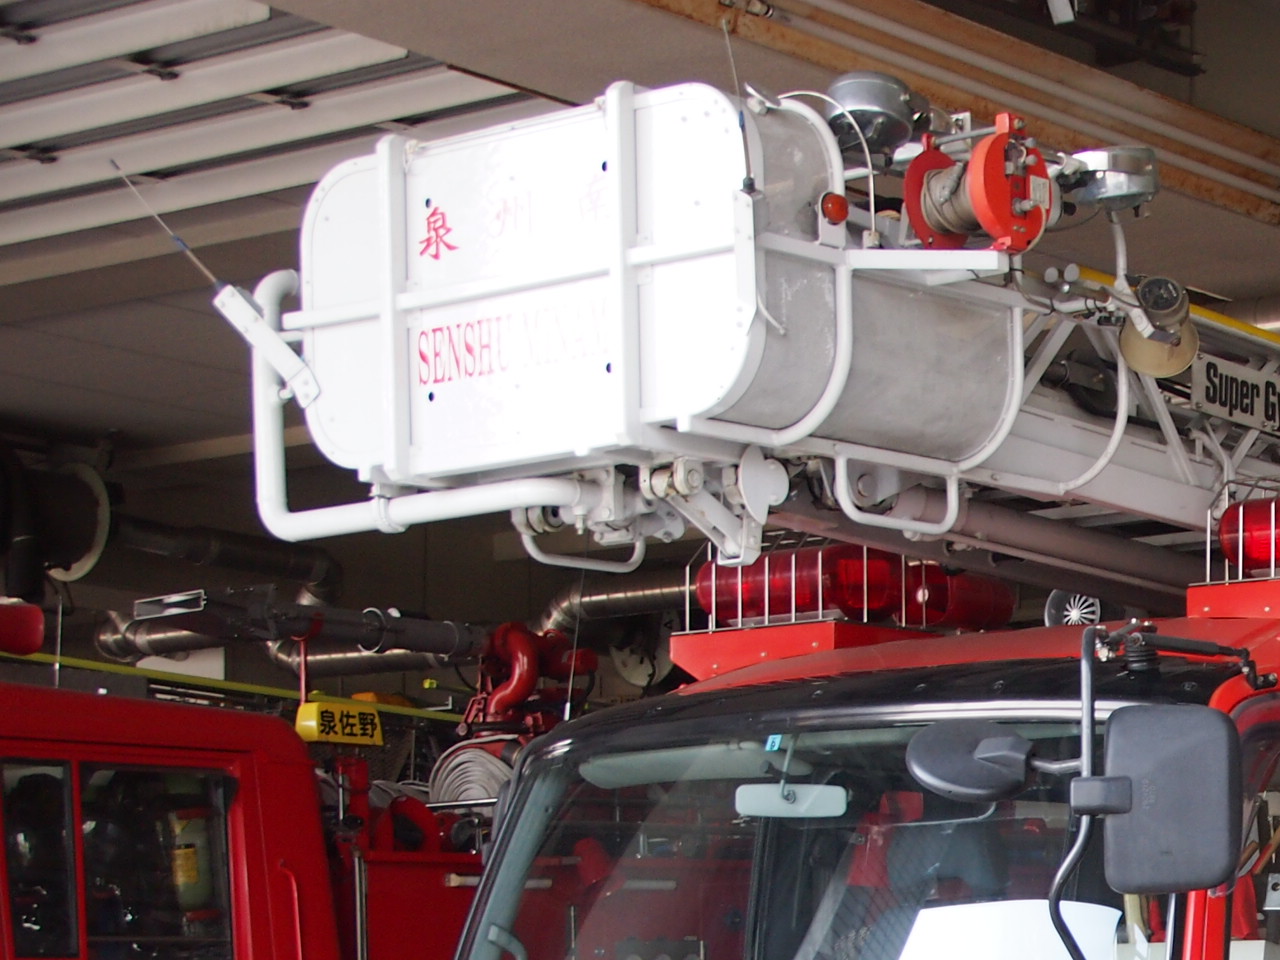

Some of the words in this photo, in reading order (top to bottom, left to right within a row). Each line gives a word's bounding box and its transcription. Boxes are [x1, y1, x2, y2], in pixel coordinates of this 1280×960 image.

[1205, 361, 1260, 417] Super
[319, 709, 377, 739] 泉佐野
